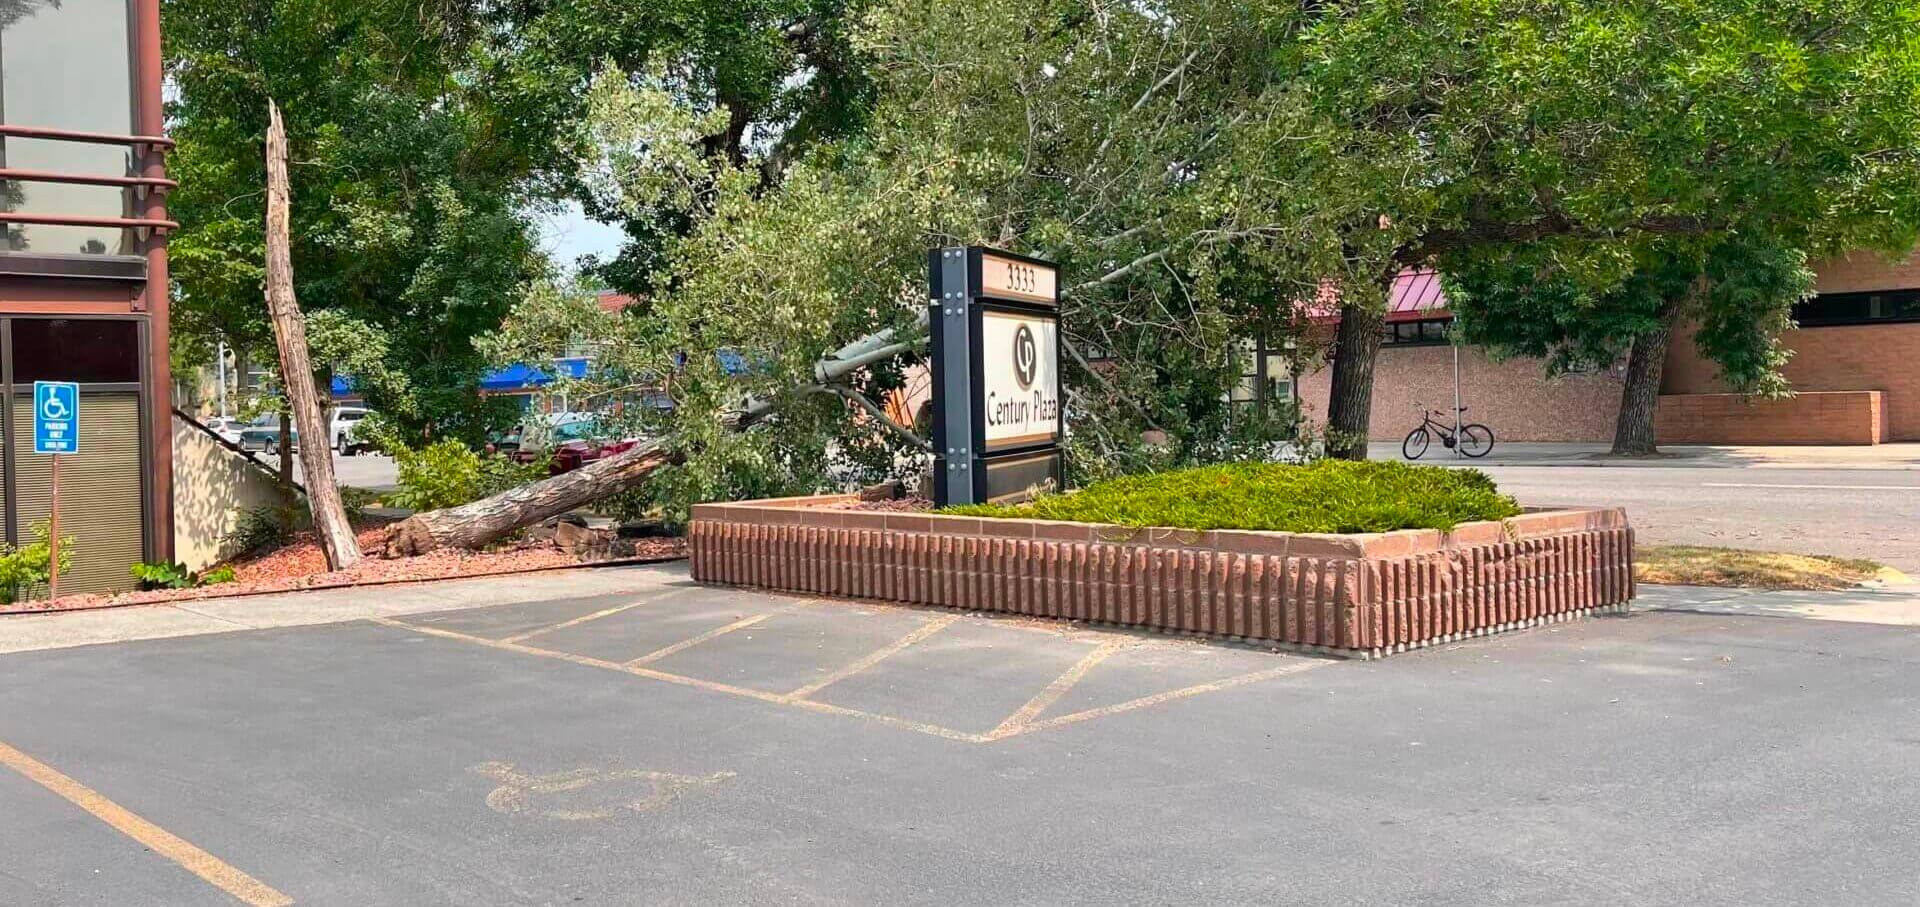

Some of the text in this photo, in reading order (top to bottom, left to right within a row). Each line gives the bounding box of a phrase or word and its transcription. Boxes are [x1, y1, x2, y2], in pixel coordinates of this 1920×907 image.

[1006, 263, 1035, 293] 3333
[987, 390, 1057, 432] Century Plaza
